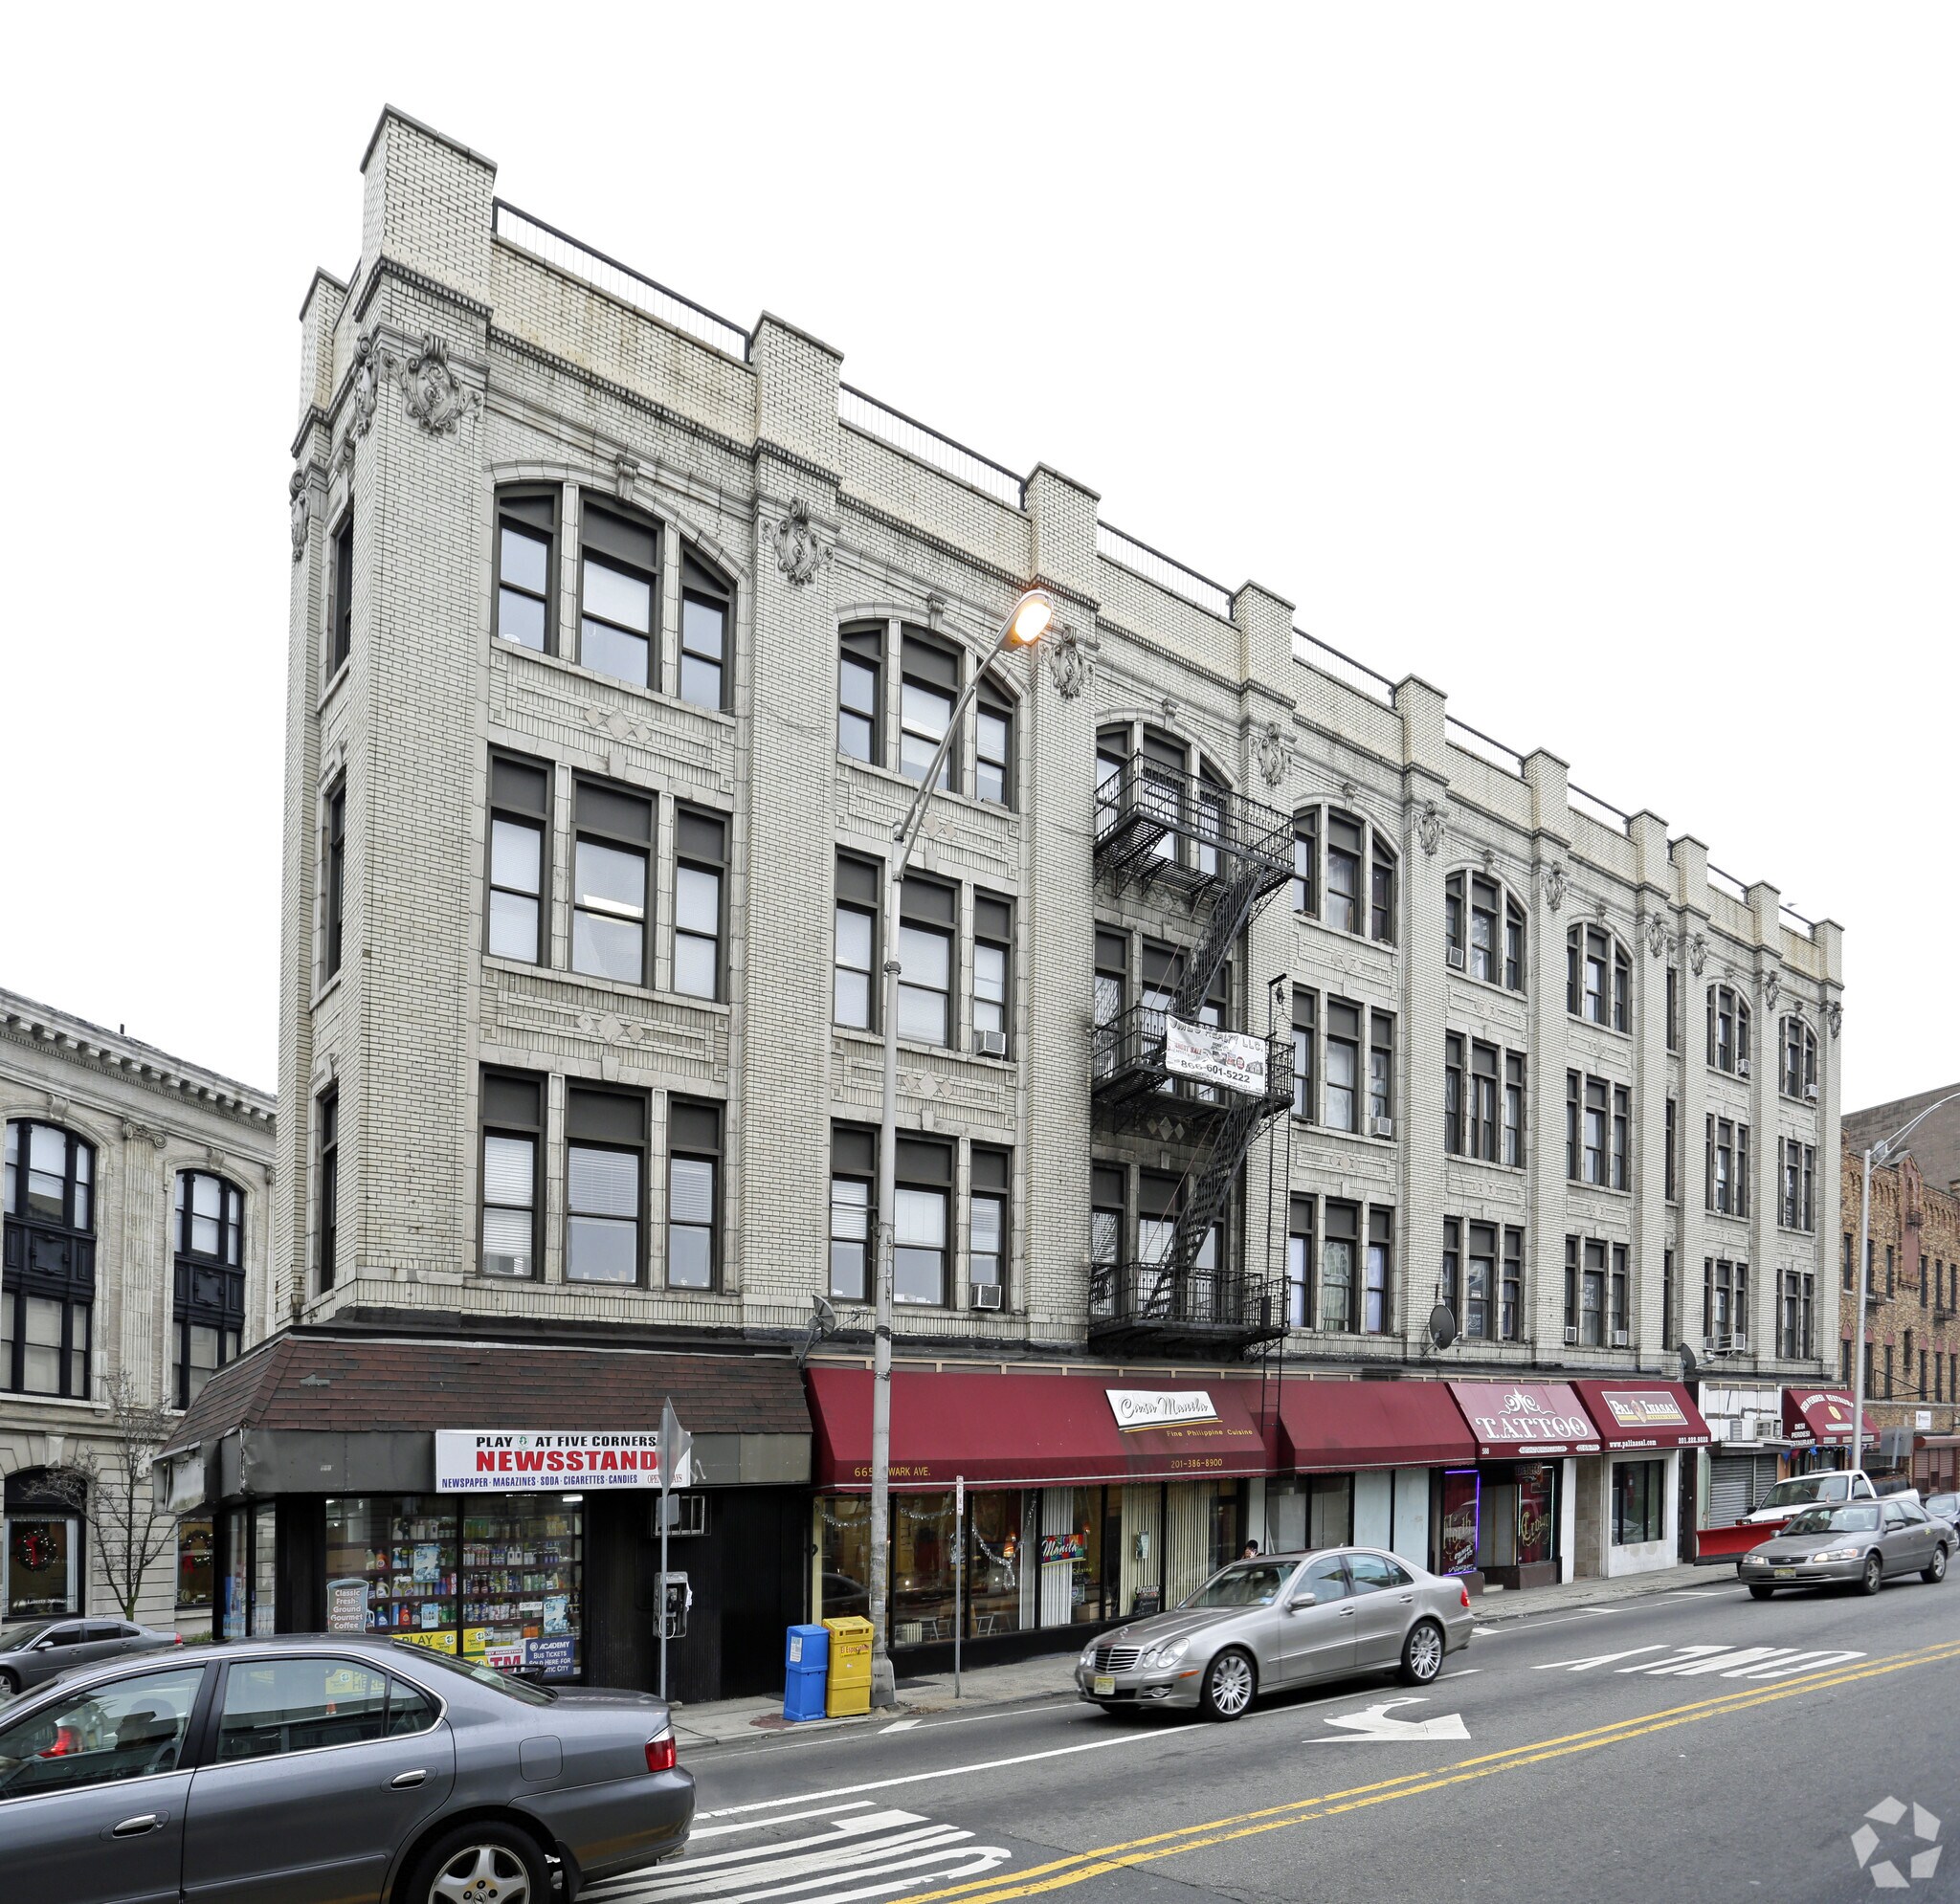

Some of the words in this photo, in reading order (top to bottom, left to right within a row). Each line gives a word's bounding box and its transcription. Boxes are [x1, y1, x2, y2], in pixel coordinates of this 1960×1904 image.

[1181, 1060, 1250, 1083] 866-601-5222
[1120, 1398, 1157, 1419] Casa
[1157, 1397, 1208, 1415] Manila
[1610, 1400, 1635, 1415] PAL
[1641, 1400, 1679, 1415] INASAL
[1475, 1416, 1588, 1439] TATTOO
[476, 1436, 513, 1448] PLAY
[535, 1436, 551, 1447] AT
[557, 1436, 588, 1447] FIVE
[591, 1436, 657, 1447] CORNERS
[1609, 1438, 1657, 1449] www.palinasal.com
[1792, 1438, 1815, 1447] STAURANT
[477, 1450, 657, 1472] NEWSSTAND
[1170, 1458, 1223, 1469] 201-386-8900
[888, 1467, 911, 1476] WARK
[913, 1467, 931, 1476] AVE.
[441, 1478, 489, 1489] NEWSPAPER
[493, 1476, 536, 1487] MAGAZINES
[540, 1476, 559, 1486] SODA
[563, 1474, 605, 1485] CIGARETTES
[609, 1474, 637, 1484] CANDIES
[1041, 1539, 1078, 1557] Manila
[539, 1641, 570, 1650] ACADEMY
